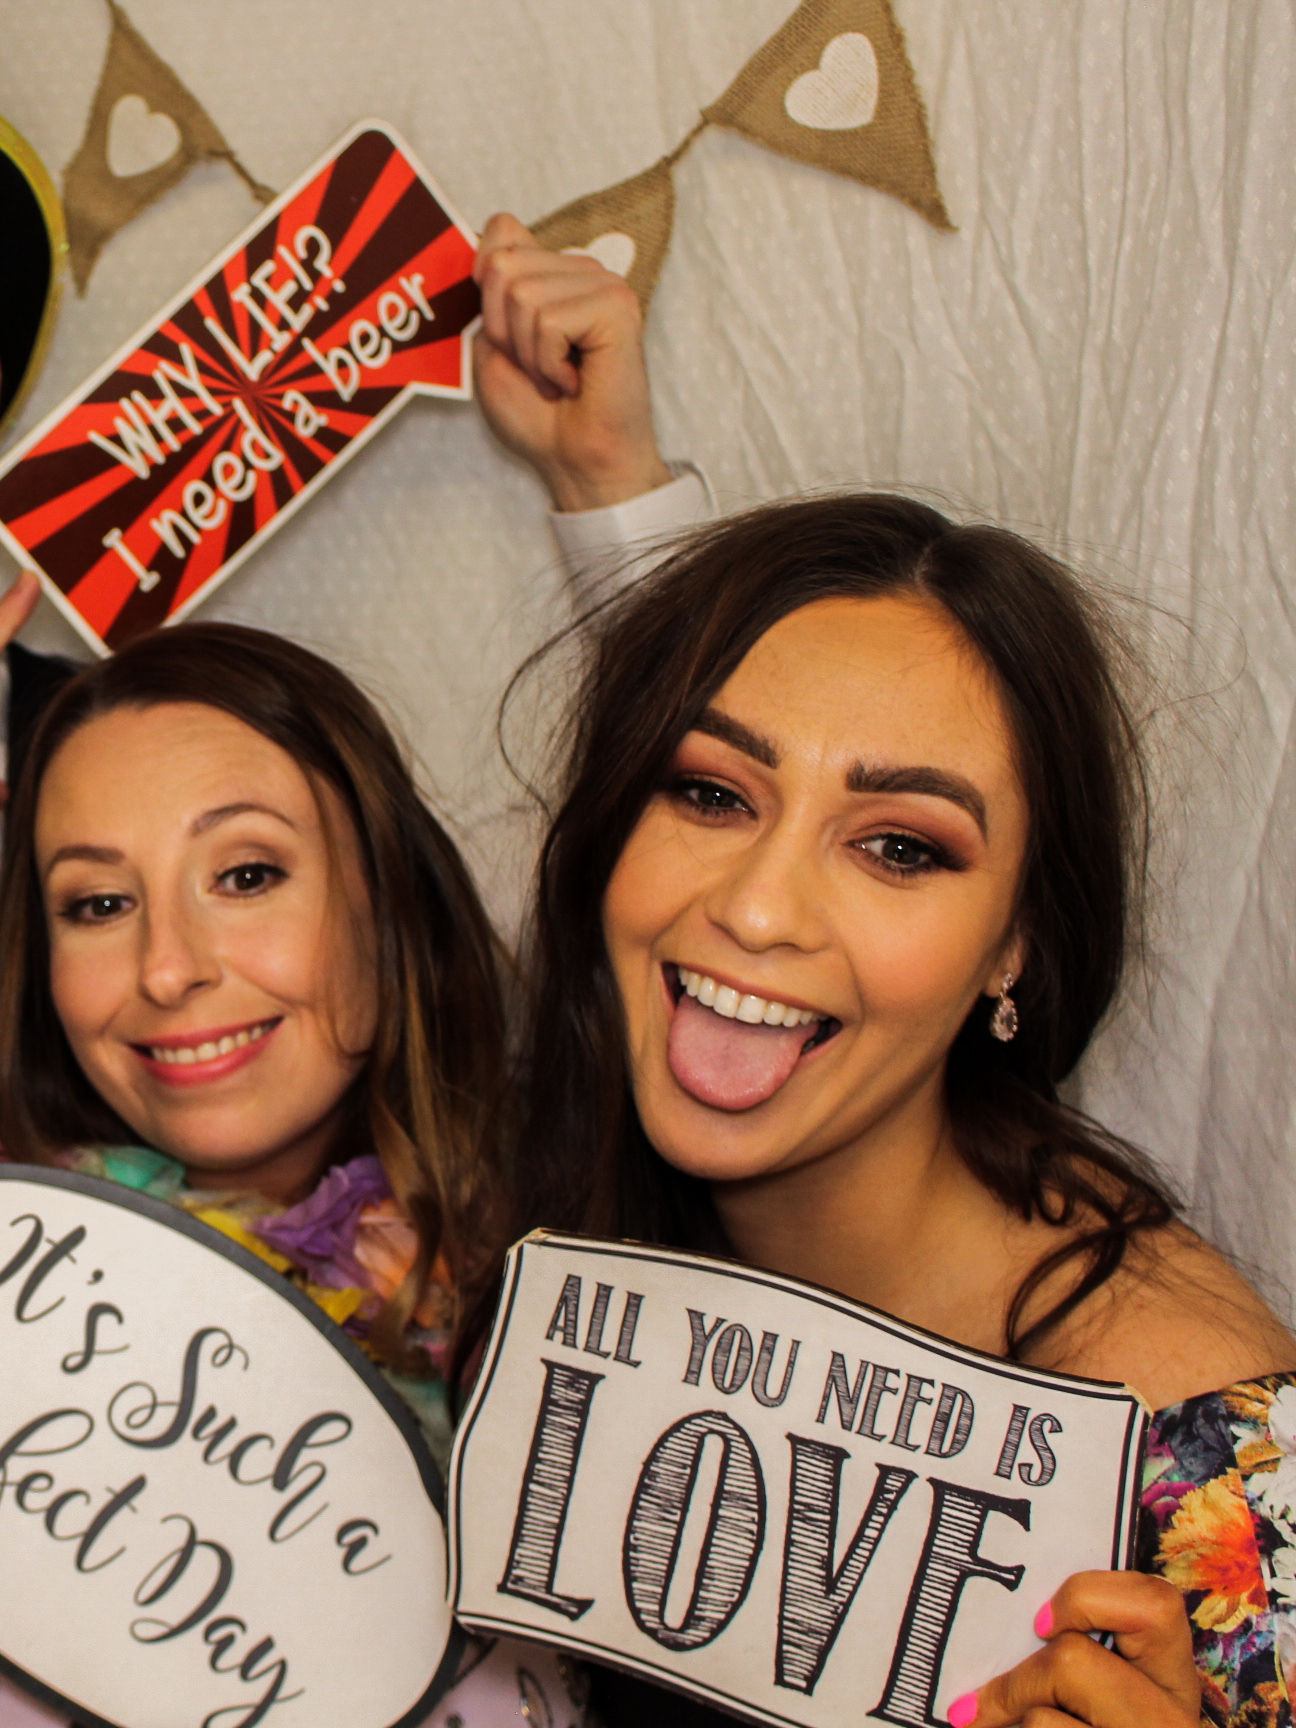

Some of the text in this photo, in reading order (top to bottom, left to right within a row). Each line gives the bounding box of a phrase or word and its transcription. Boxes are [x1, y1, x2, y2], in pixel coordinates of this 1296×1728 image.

[87, 224, 346, 480] WHY LIE!?
[103, 272, 436, 592] I need a beer
[108, 1327, 353, 1543] Such
[335, 1518, 392, 1575] a
[545, 1273, 1063, 1487] ALL YOU NEED IS
[129, 1514, 306, 1728] Day
[496, 1357, 1032, 1728] LOVE
